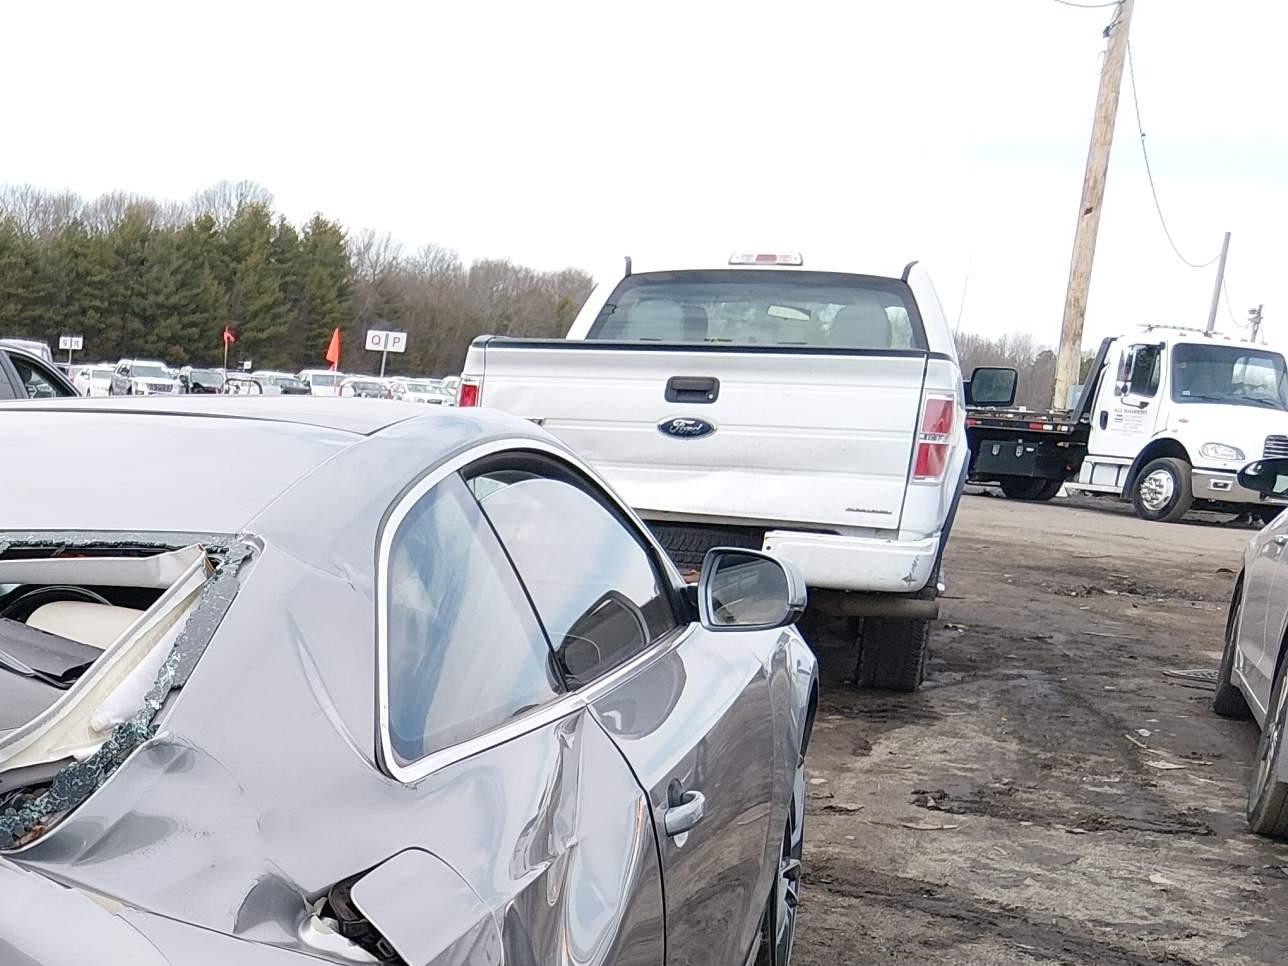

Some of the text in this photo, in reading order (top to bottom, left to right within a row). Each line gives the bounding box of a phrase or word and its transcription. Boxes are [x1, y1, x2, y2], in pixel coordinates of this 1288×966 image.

[371, 334, 381, 346] Q
[392, 336, 401, 348] P
[669, 419, 703, 434] Ford
